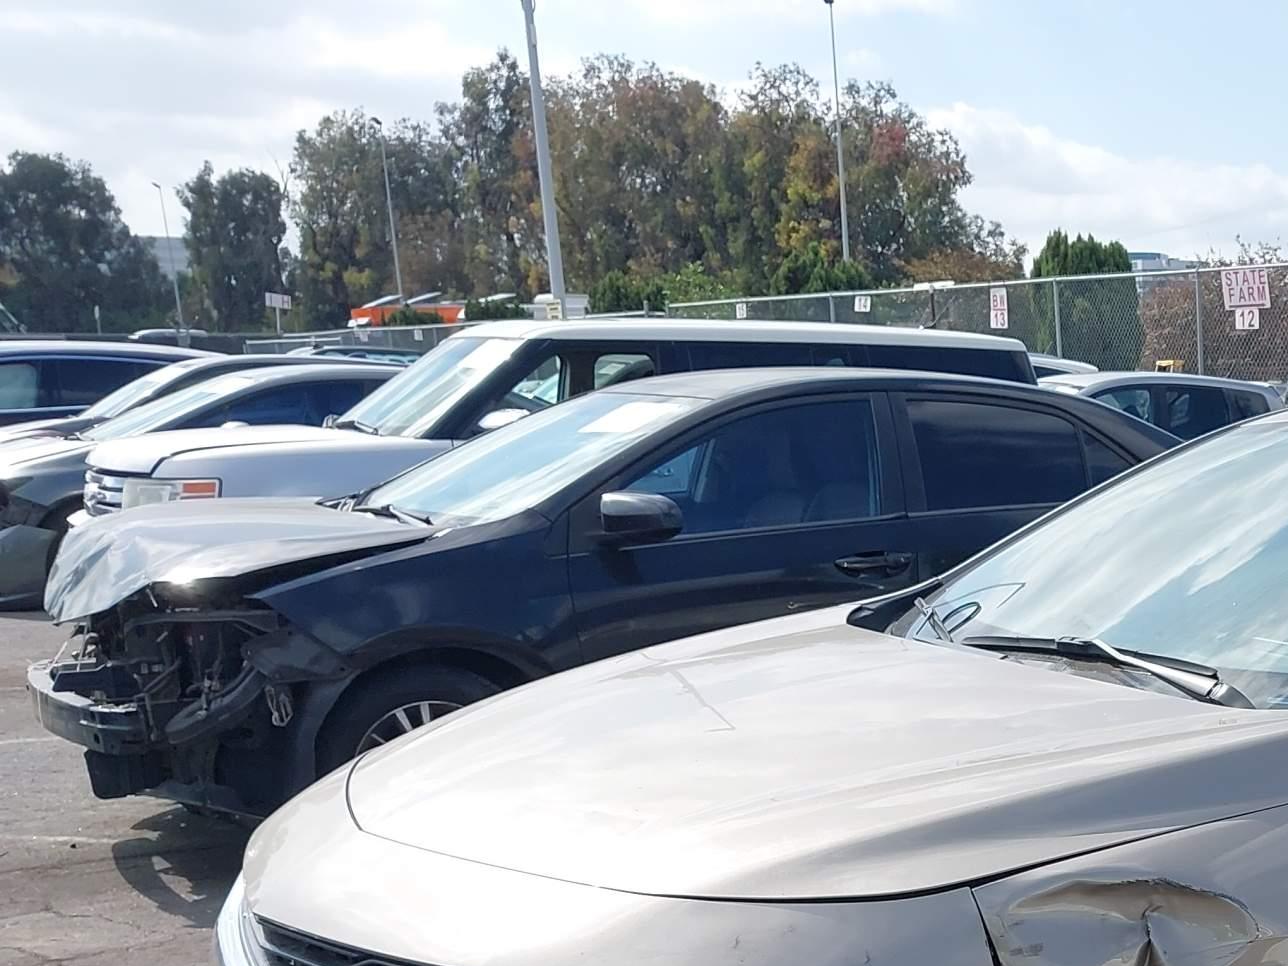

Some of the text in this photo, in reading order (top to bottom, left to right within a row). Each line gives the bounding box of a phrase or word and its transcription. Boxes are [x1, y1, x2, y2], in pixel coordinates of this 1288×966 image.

[1224, 269, 1266, 287] STATE
[1228, 285, 1267, 304] FARM
[993, 311, 1006, 327] 13
[1239, 310, 1255, 328] 12
